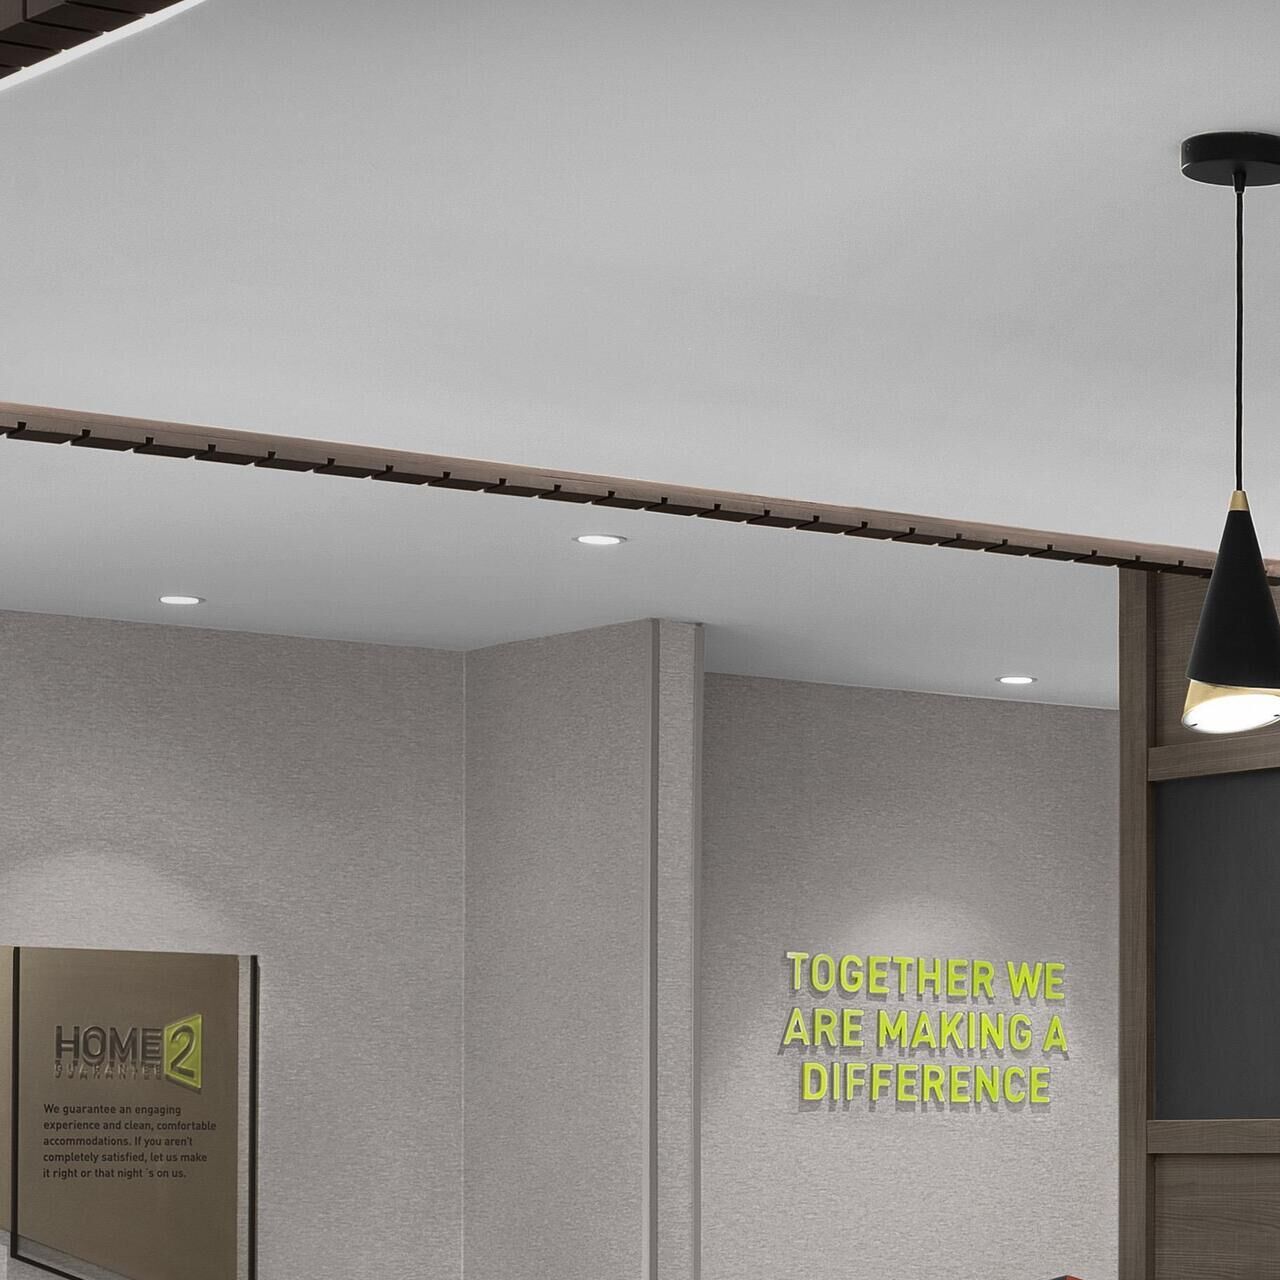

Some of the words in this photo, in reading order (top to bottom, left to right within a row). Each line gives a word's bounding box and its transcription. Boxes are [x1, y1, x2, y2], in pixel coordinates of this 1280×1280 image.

[786, 951, 995, 998] TOGETHER
[1008, 961, 1066, 1000] WE
[783, 1008, 865, 1047] ARE
[878, 1010, 1032, 1052] MAKING
[1043, 1016, 1068, 1052] A
[803, 1062, 1051, 1104] DIFFERENCE
[43, 1103, 60, 1114] We
[62, 1105, 117, 1116] guarantee
[119, 1106, 132, 1114] an
[135, 1105, 182, 1117] engaging
[43, 1120, 100, 1132] experience
[103, 1120, 122, 1130] and
[124, 1120, 154, 1132] clean,
[157, 1120, 217, 1131] comfortable
[43, 1136, 132, 1146] accommodations.
[135, 1136, 142, 1146] If
[144, 1138, 161, 1148] you
[43, 1152, 99, 1164] completely
[101, 1152, 148, 1163] satisfied,
[150, 1152, 164, 1162] let
[166, 1154, 178, 1162] us
[180, 1152, 208, 1162] make
[43, 1168, 50, 1178] it
[52, 1168, 78, 1180] right
[80, 1170, 92, 1178] or
[94, 1168, 115, 1178] that
[156, 1170, 169, 1178] on
